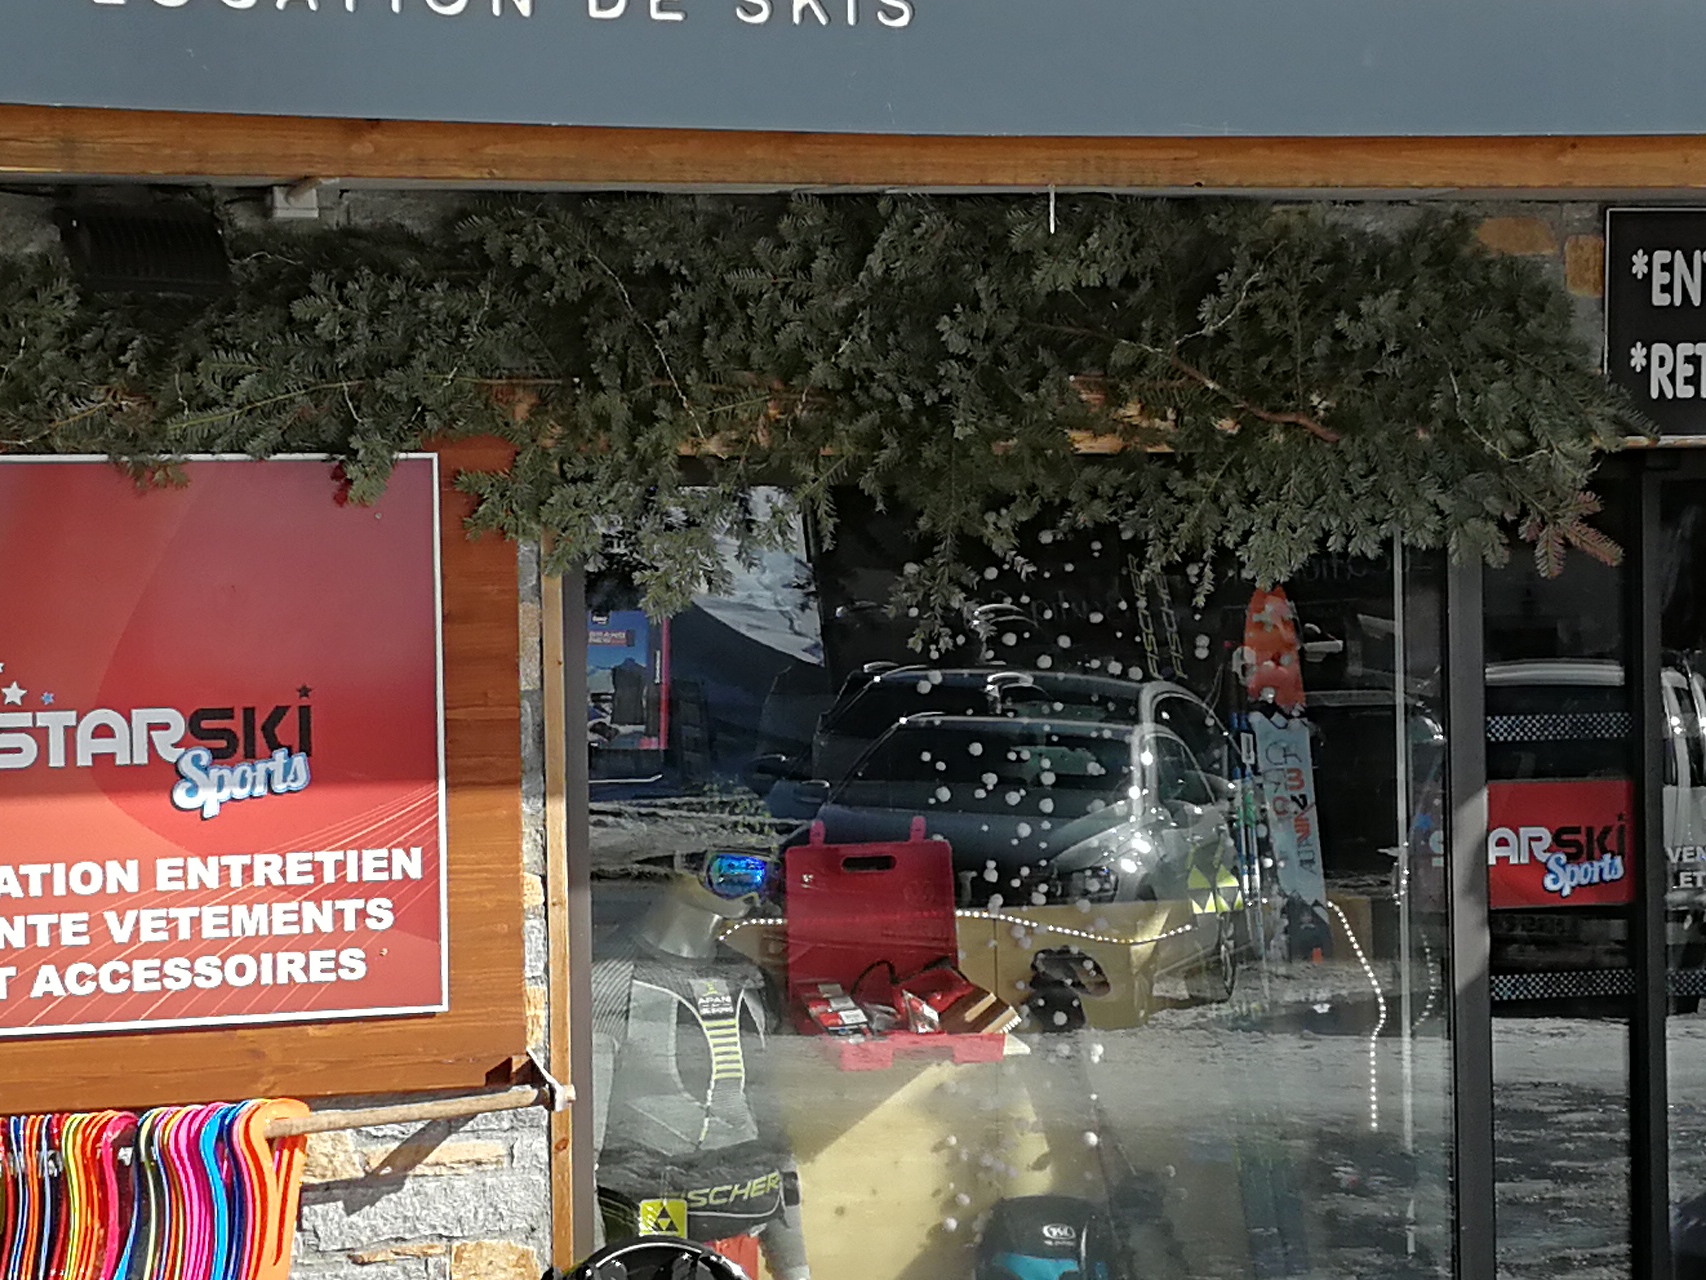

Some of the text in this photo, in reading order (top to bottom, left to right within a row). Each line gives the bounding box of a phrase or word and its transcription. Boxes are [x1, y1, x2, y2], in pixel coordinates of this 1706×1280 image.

[173, 746, 311, 819] Sports
[155, 846, 423, 892] ENTRETIEN
[1543, 851, 1626, 898] Sports
[103, 897, 395, 944] VETEMENTS
[29, 947, 368, 999] ACCESSOIRES
